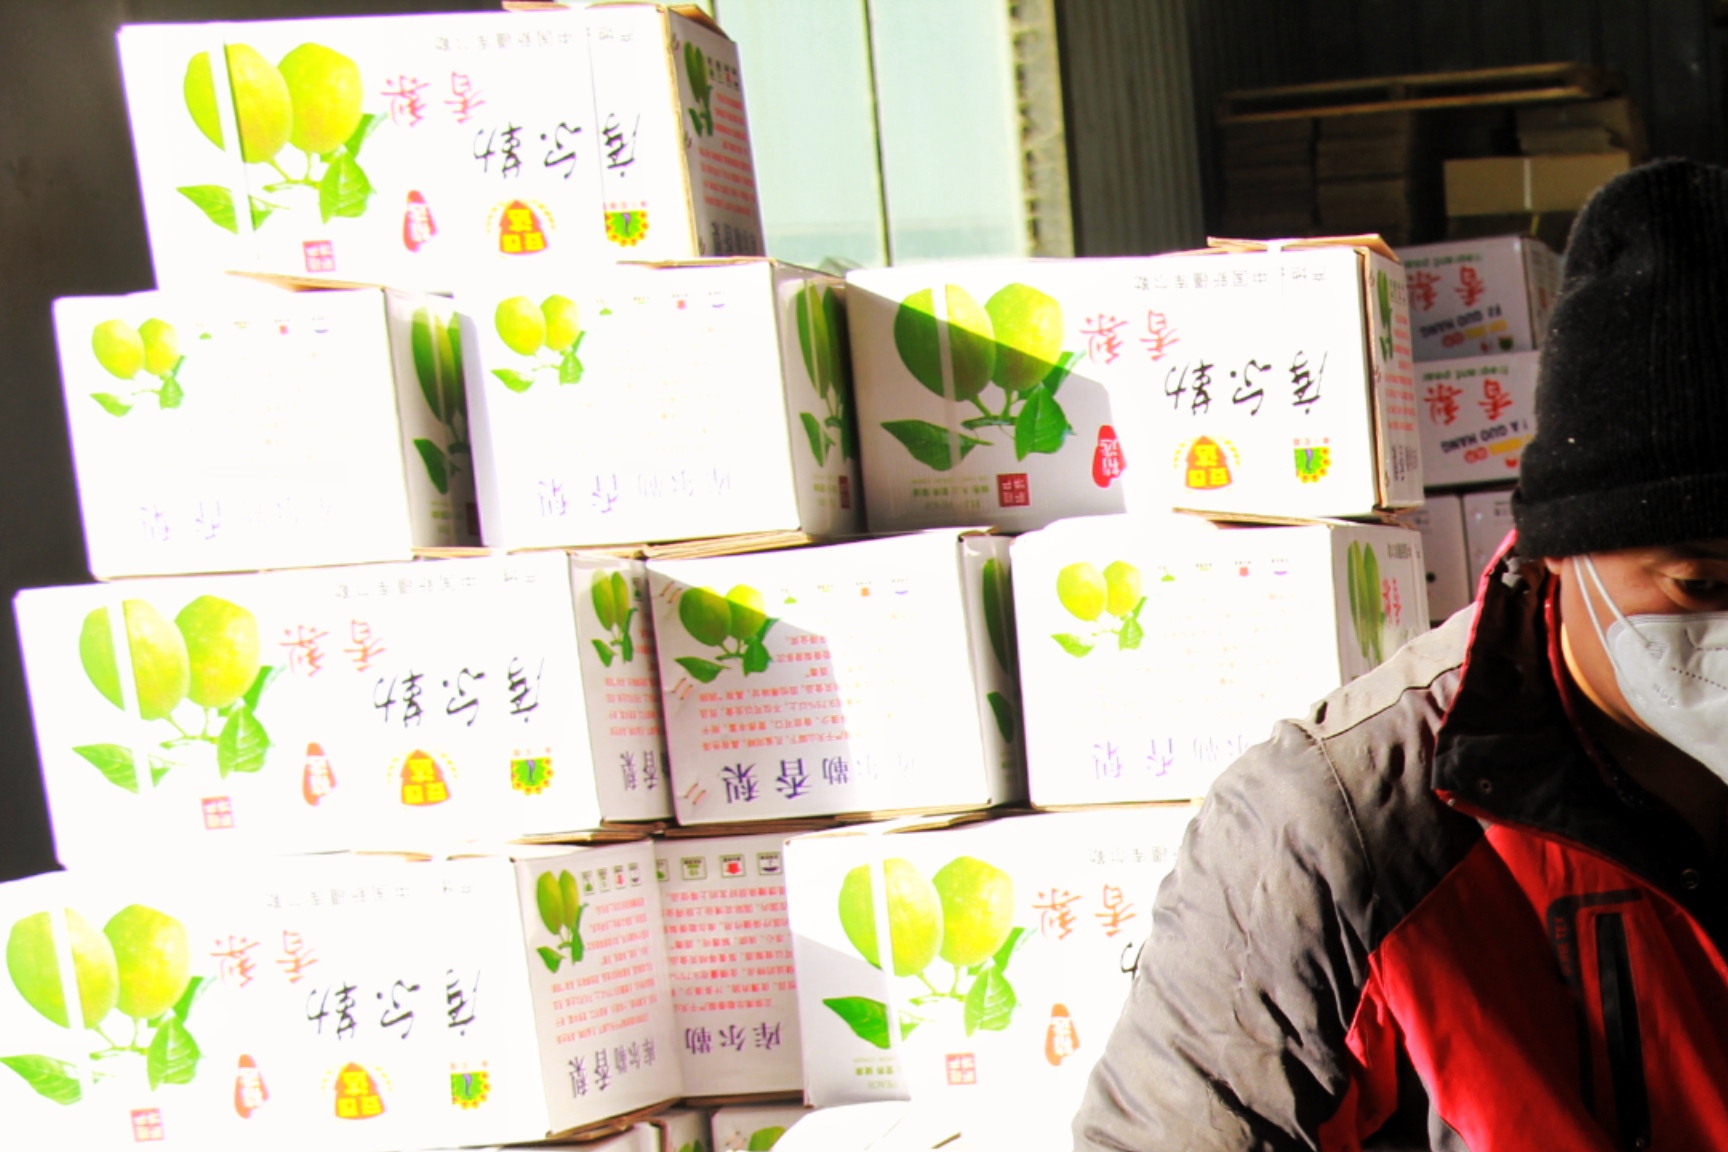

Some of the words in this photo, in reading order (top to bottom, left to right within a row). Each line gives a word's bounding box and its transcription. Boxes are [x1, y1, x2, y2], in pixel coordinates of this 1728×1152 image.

[380, 70, 484, 126] 香梨
[471, 112, 639, 179] 库尔勒
[1078, 308, 1179, 365] 香梨
[1163, 349, 1327, 415] 库尔勒
[1423, 378, 1511, 424] 香梨
[278, 618, 385, 676] 香梨
[371, 656, 544, 727] 库尔勒
[1031, 883, 1135, 939] 香梨
[209, 929, 317, 988] 香梨
[683, 1021, 780, 1054] 库尔勒
